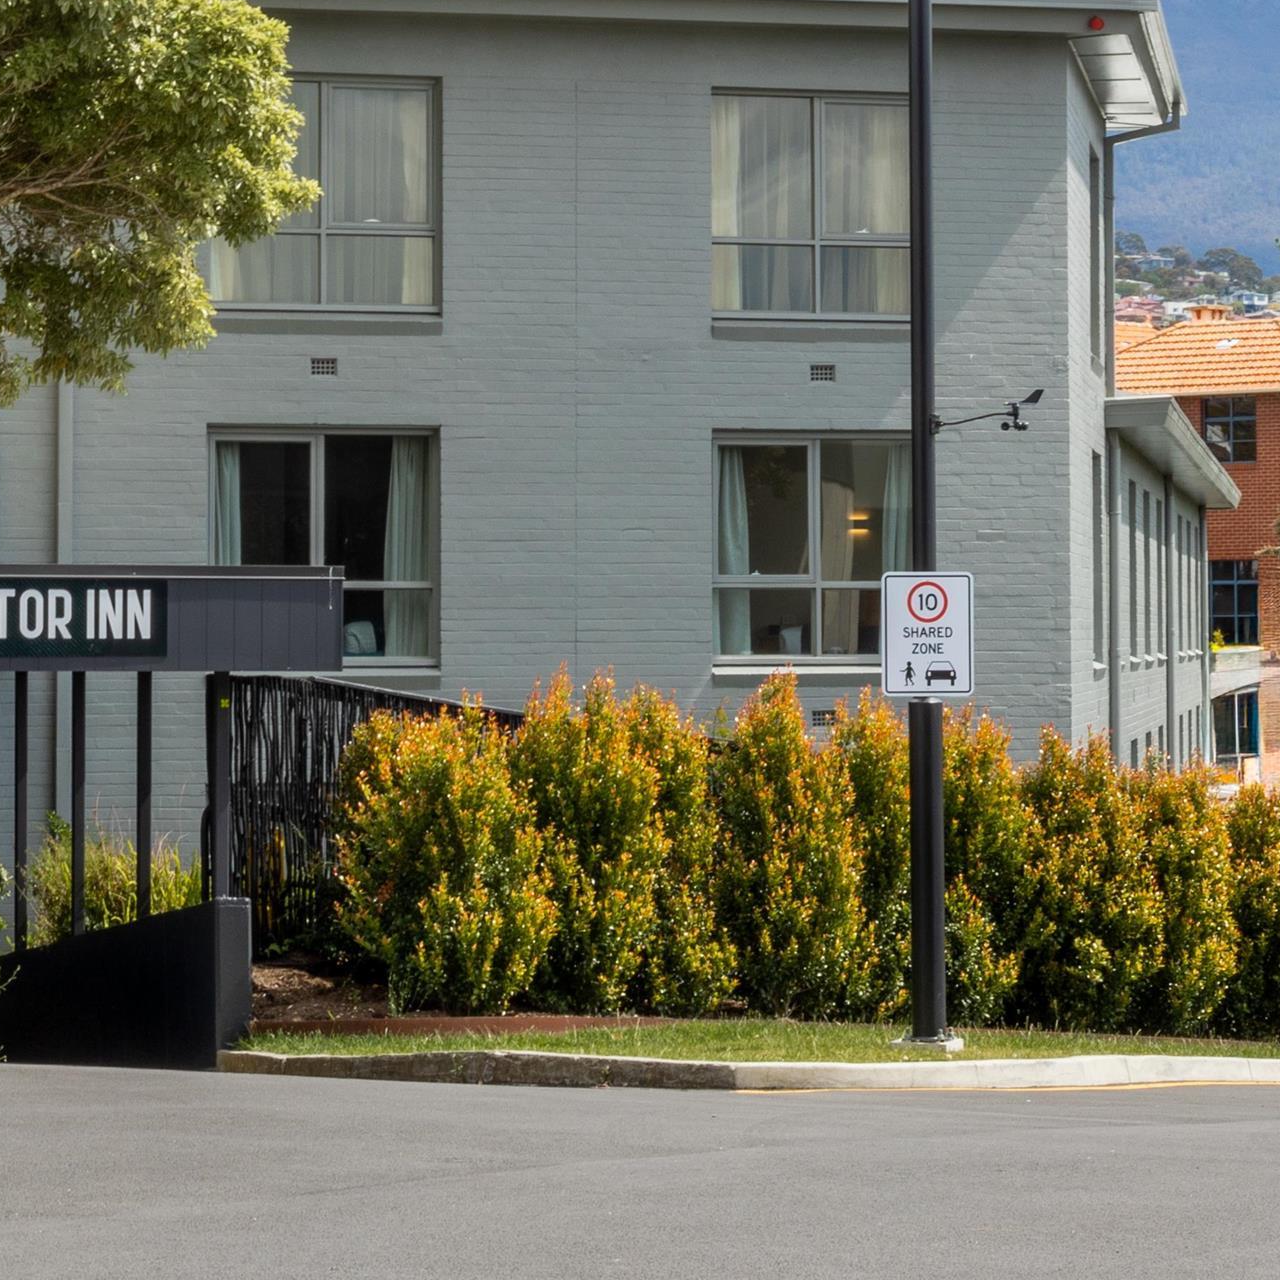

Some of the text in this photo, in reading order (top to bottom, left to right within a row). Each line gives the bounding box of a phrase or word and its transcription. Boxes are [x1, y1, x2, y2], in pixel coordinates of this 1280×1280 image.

[918, 593, 938, 611] 10
[86, 589, 151, 639] INN
[902, 626, 953, 638] SHARED
[911, 643, 944, 654] ZONE
